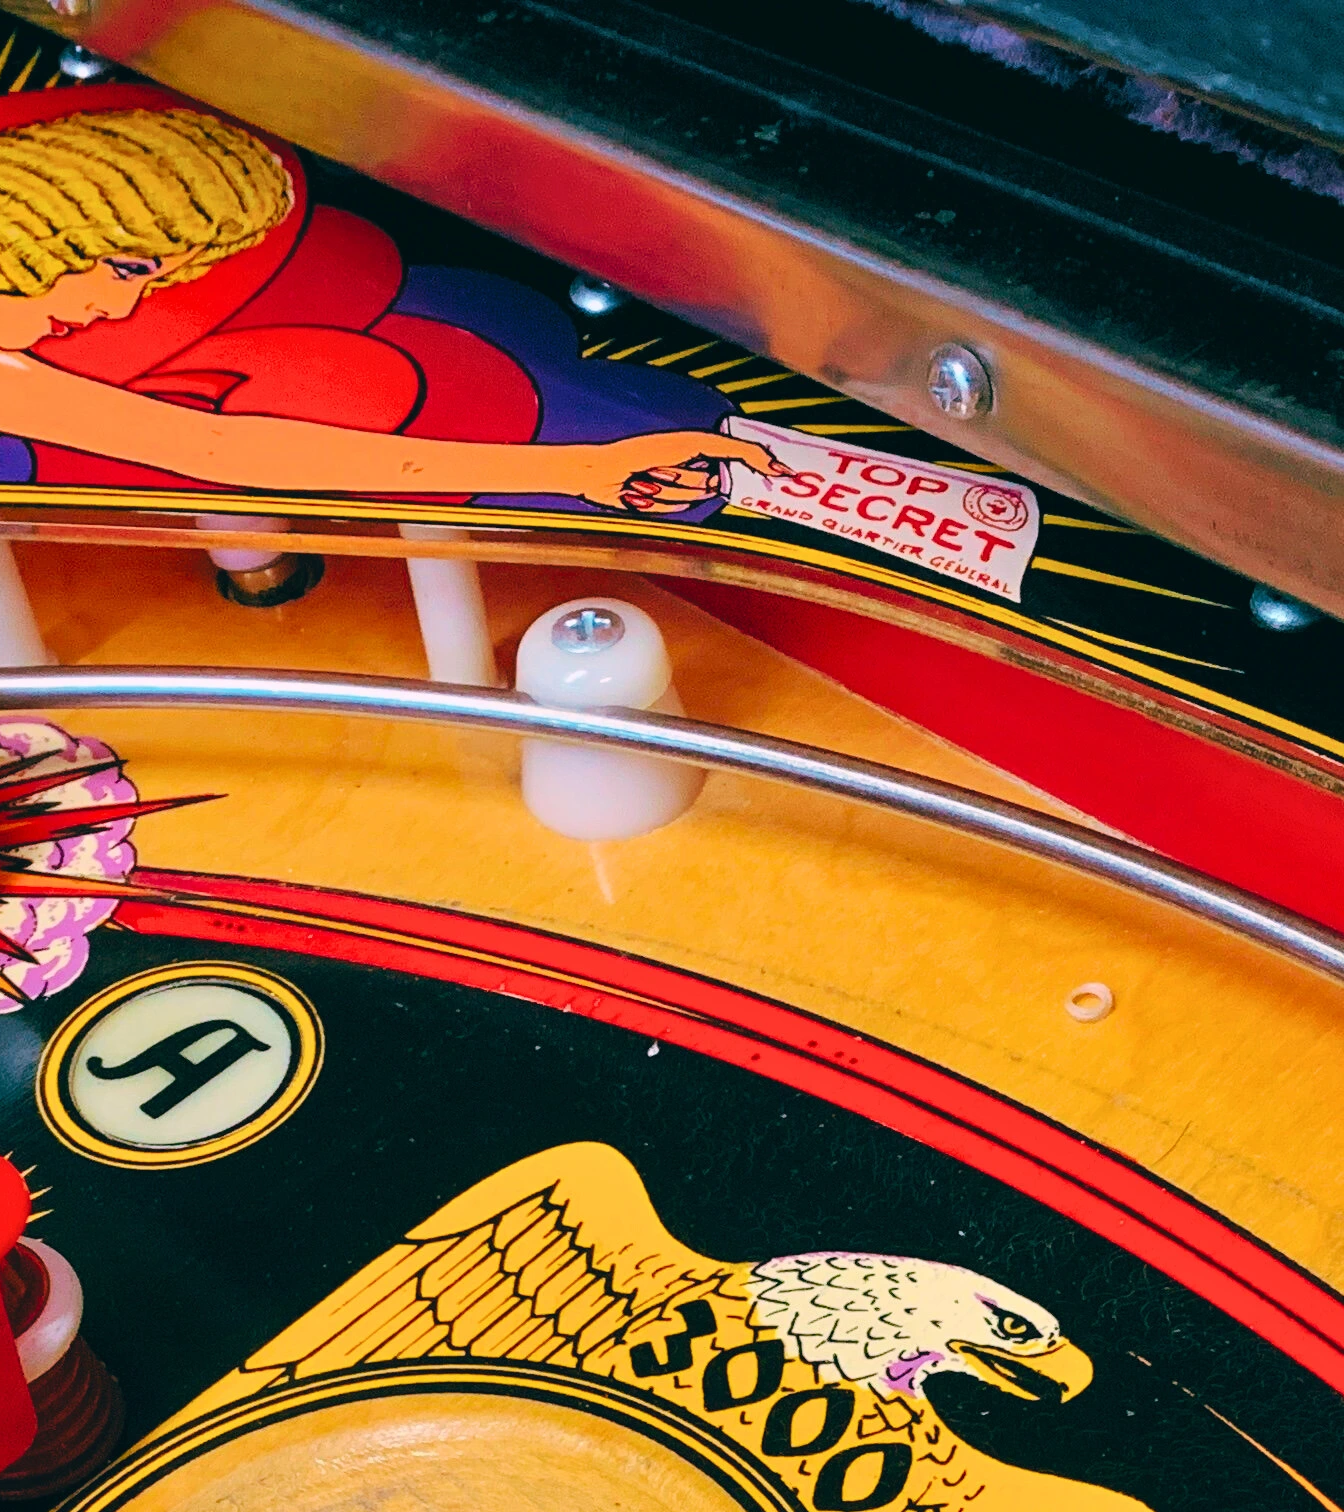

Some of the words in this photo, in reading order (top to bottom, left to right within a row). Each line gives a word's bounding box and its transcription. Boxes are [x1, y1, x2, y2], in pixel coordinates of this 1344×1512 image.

[780, 471, 1016, 564] SECRET
[827, 450, 949, 497] TOP
[740, 496, 814, 521] GRAND
[821, 518, 924, 560] QUARTIER
[86, 1019, 271, 1119] A
[629, 1299, 913, 1512] 3000
